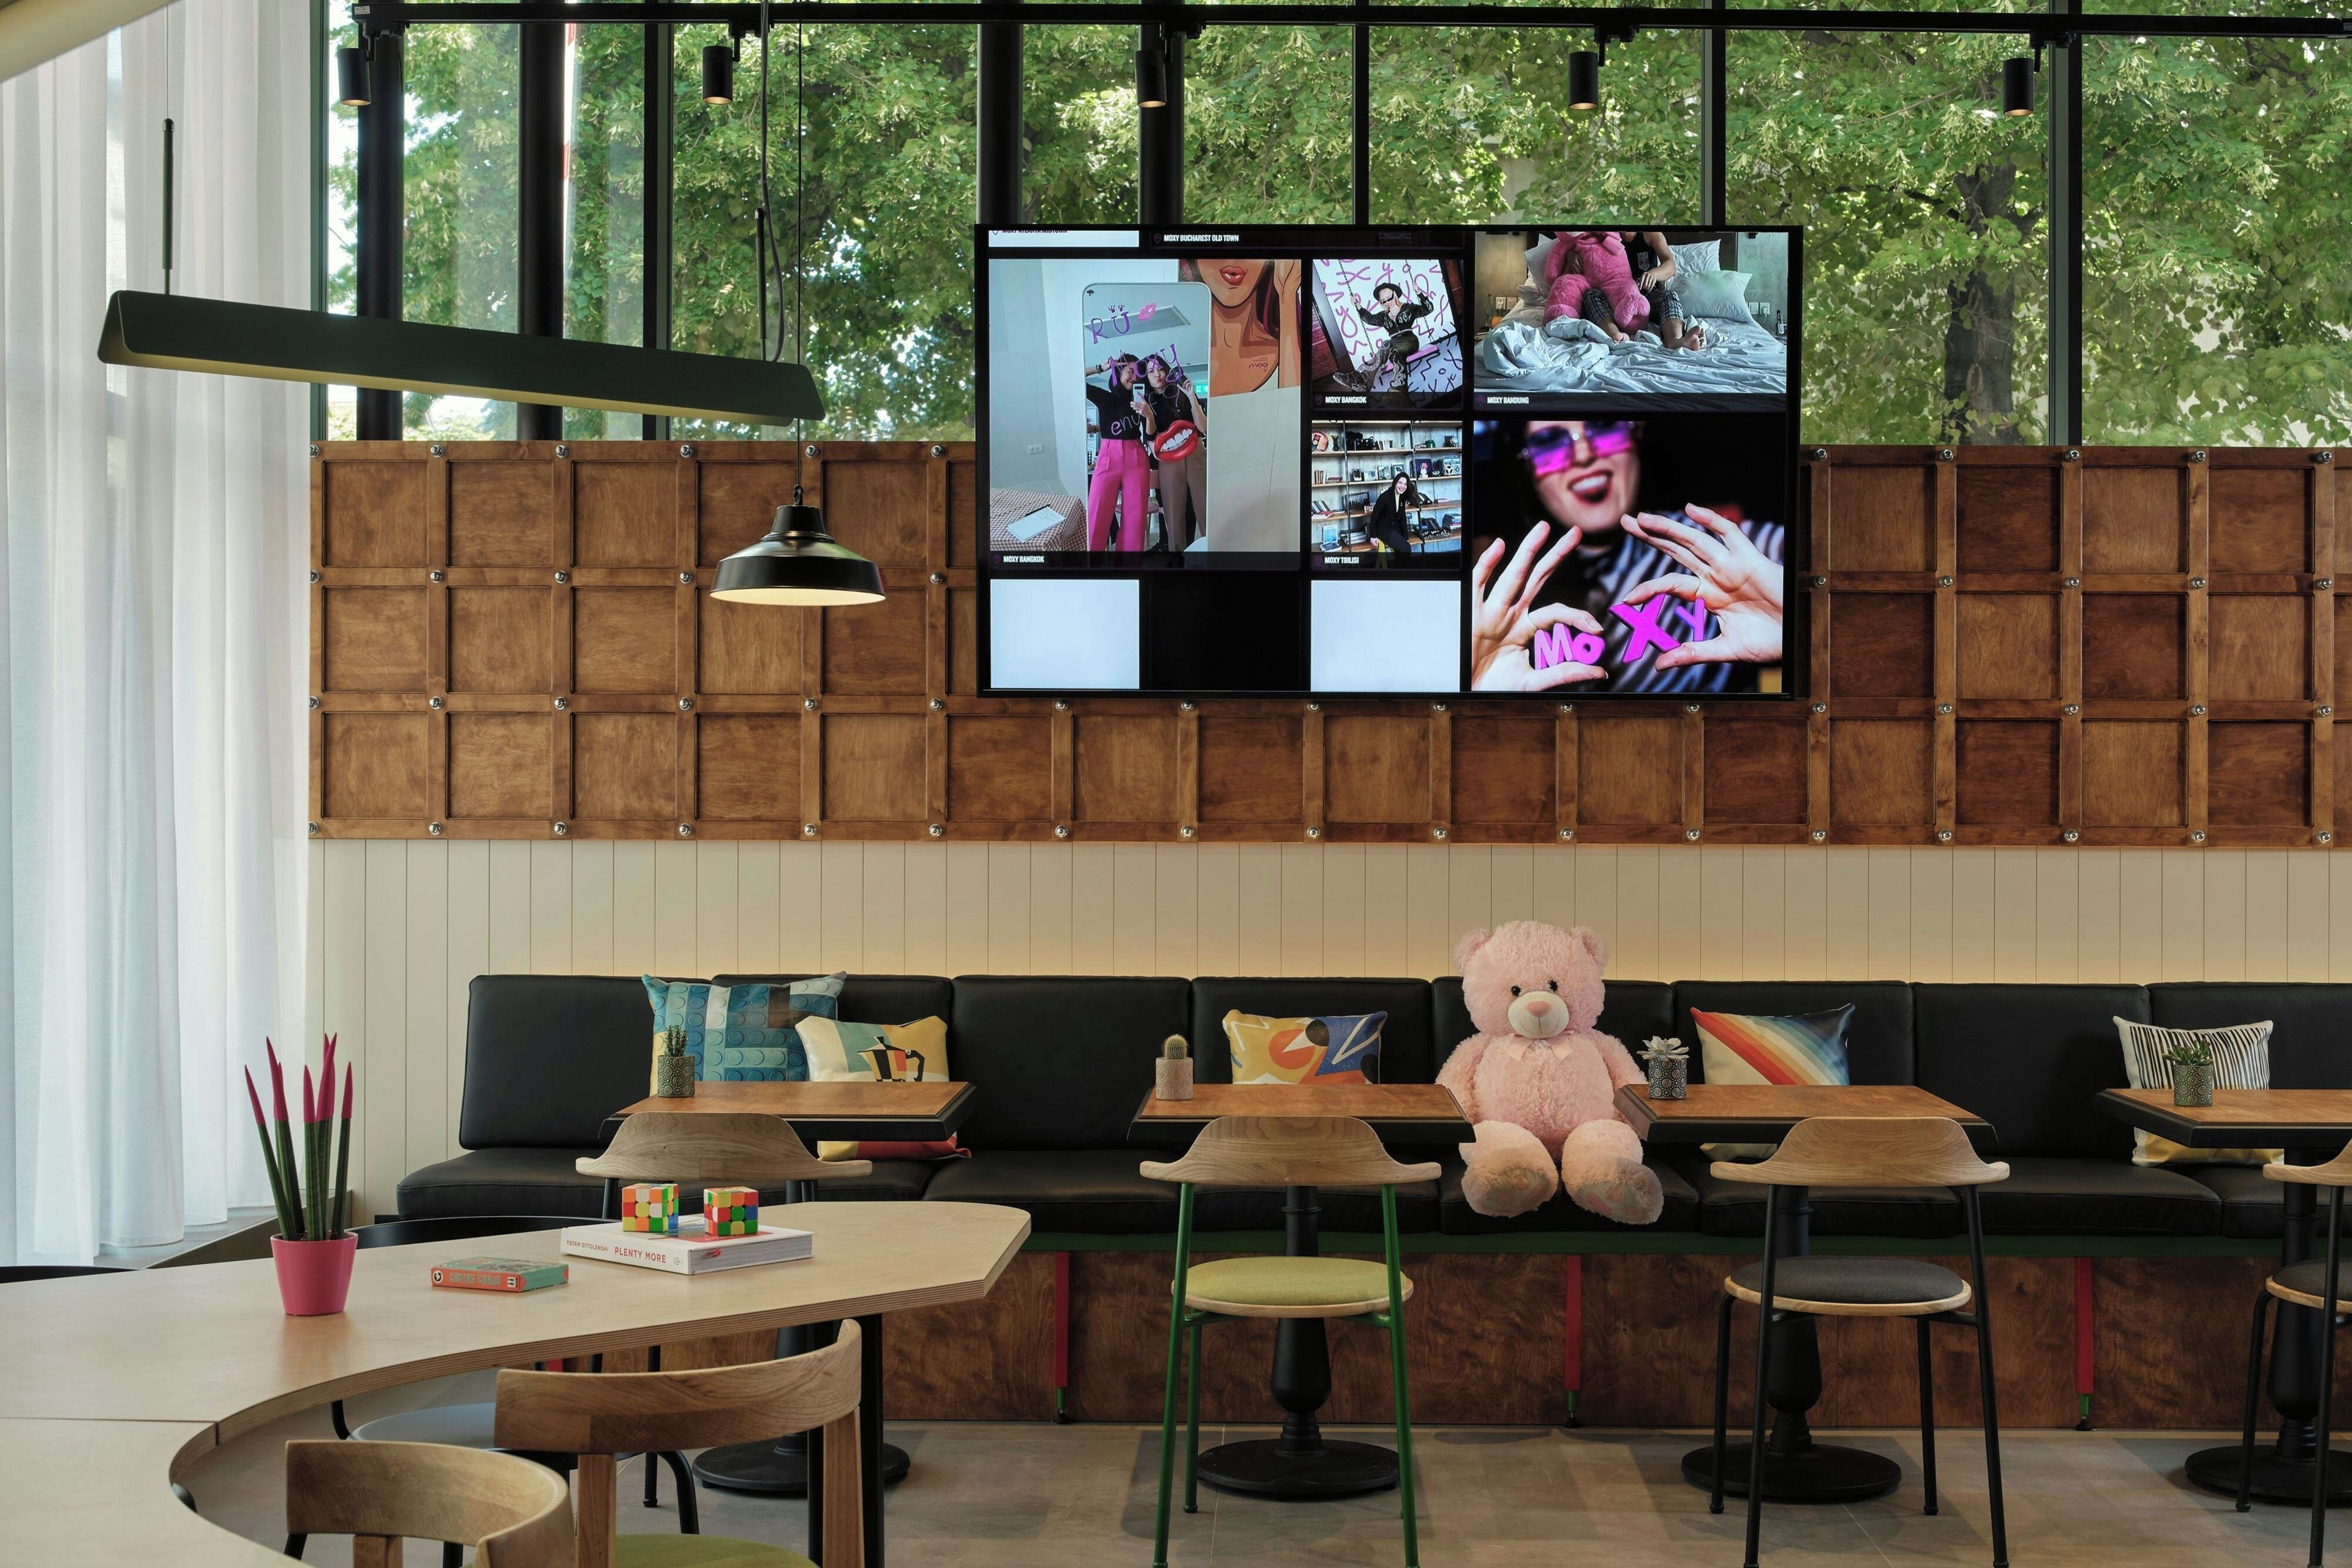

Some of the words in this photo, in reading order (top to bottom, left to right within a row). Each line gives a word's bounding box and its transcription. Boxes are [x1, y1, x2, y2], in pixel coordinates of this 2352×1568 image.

[581, 1242, 608, 1252] OTTOLENGHI
[614, 1246, 643, 1259] PLENTY
[645, 1252, 666, 1264] MORE
